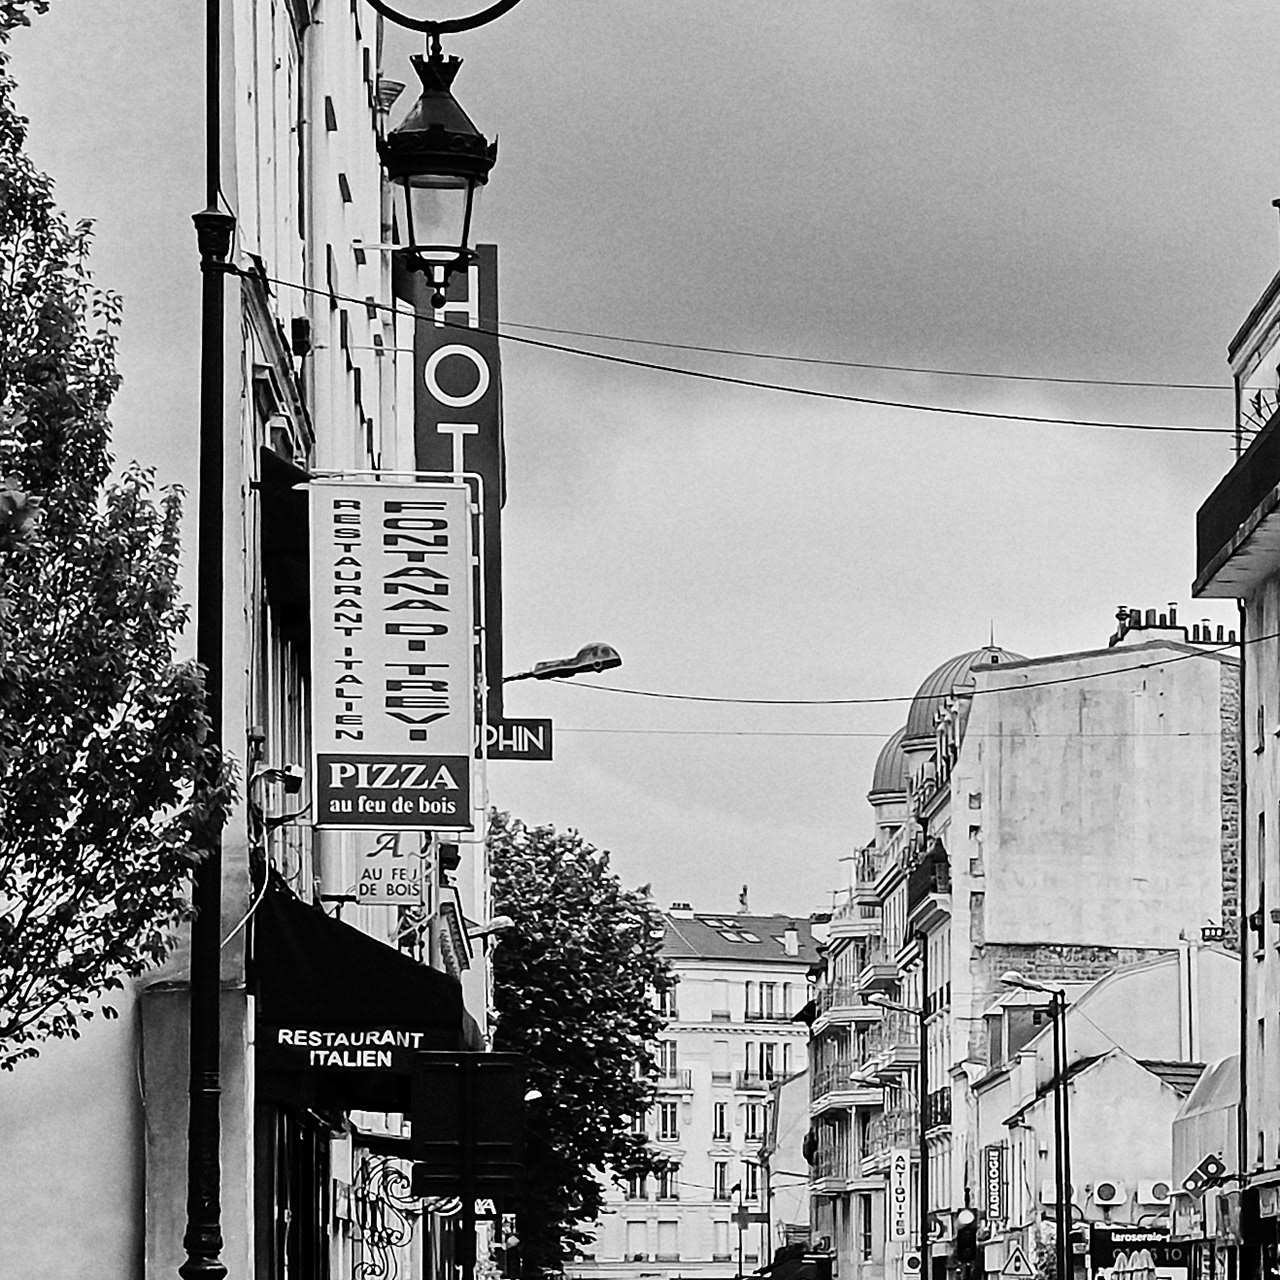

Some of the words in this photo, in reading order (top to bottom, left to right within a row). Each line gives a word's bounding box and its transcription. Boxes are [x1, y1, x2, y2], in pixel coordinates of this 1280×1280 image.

[383, 501, 450, 611] FONTANA
[333, 500, 362, 636] RESTAURANT
[384, 623, 448, 651] DI
[334, 647, 363, 740] ITALIEN
[384, 664, 450, 741] TREVI
[328, 762, 460, 790] PIZZA
[329, 800, 353, 814] au
[358, 796, 387, 814] feu
[391, 796, 414, 815] de
[418, 797, 457, 814] bois
[361, 868, 383, 880] AU
[358, 884, 378, 897] DE
[386, 884, 420, 896] BOIS
[278, 1029, 424, 1048] RESTAURANT
[310, 1050, 392, 1067] ITALIEN
[1164, 1248, 1182, 1260] 10
